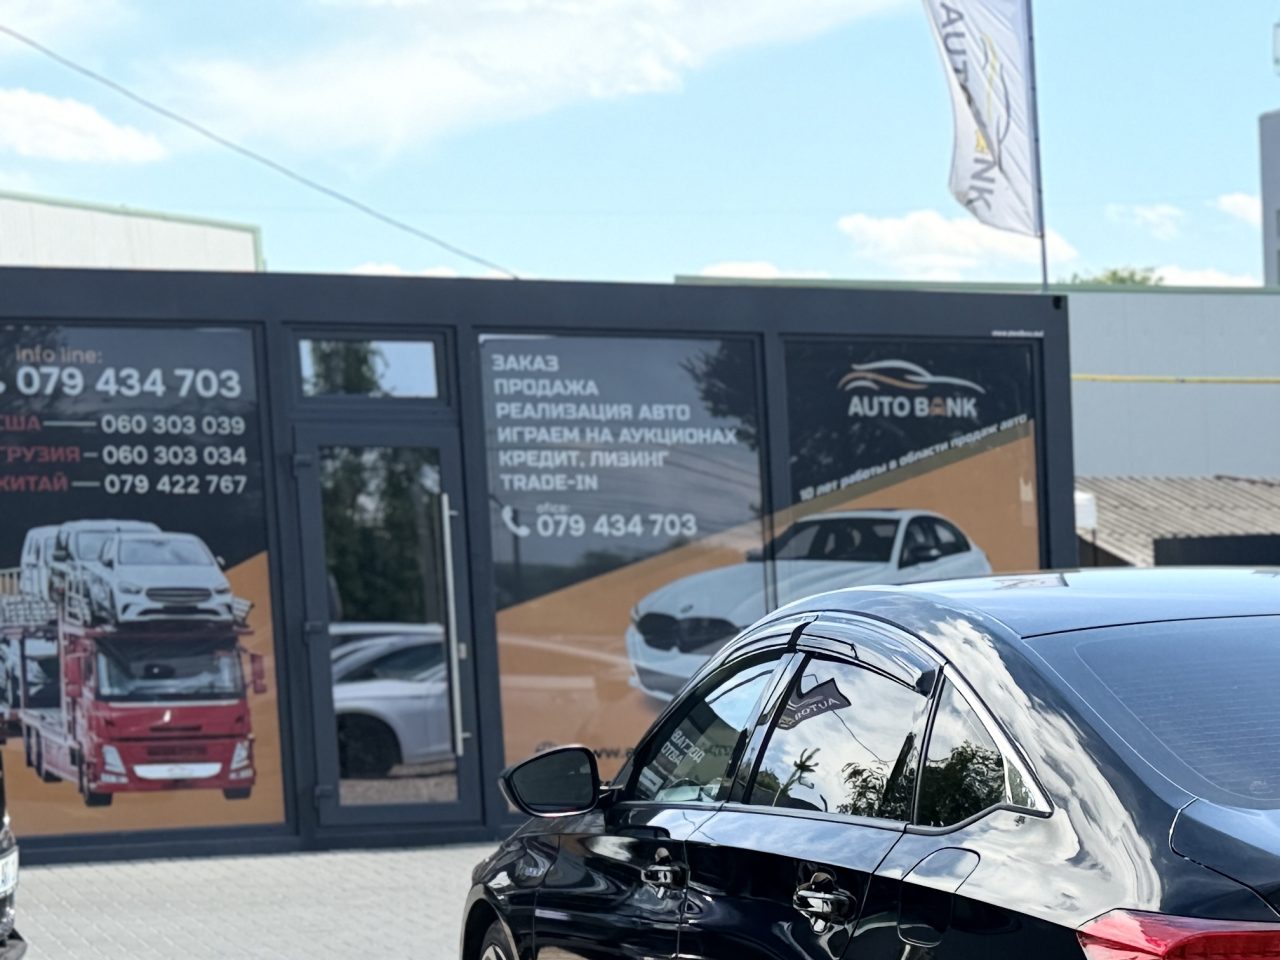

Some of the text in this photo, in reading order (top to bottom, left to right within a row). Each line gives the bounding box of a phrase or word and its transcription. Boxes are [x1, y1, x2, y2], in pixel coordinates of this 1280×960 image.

[16, 344, 56, 363] info
[491, 354, 559, 372] ЗАКАЗ
[16, 366, 242, 398] 079 434 703
[494, 378, 599, 397] ПРОДАЖА
[496, 402, 691, 421] РЕАЛИЗАЦИЯ АВТО
[848, 396, 977, 418] AUTO BANK
[101, 414, 147, 434] 060
[153, 415, 196, 435] 303
[202, 416, 245, 435] 039
[497, 426, 738, 445] ИГРАЕМ НА АУКЦИОНАХ
[102, 445, 148, 465] 060
[154, 446, 198, 466] 303
[203, 446, 248, 466] 034
[590, 451, 669, 468] ЛИЗИНГ
[104, 474, 150, 494] 079
[156, 474, 200, 494] 422
[205, 474, 248, 494] 767
[500, 474, 598, 491] TRADE-IN
[536, 513, 697, 537] 079 434 703
